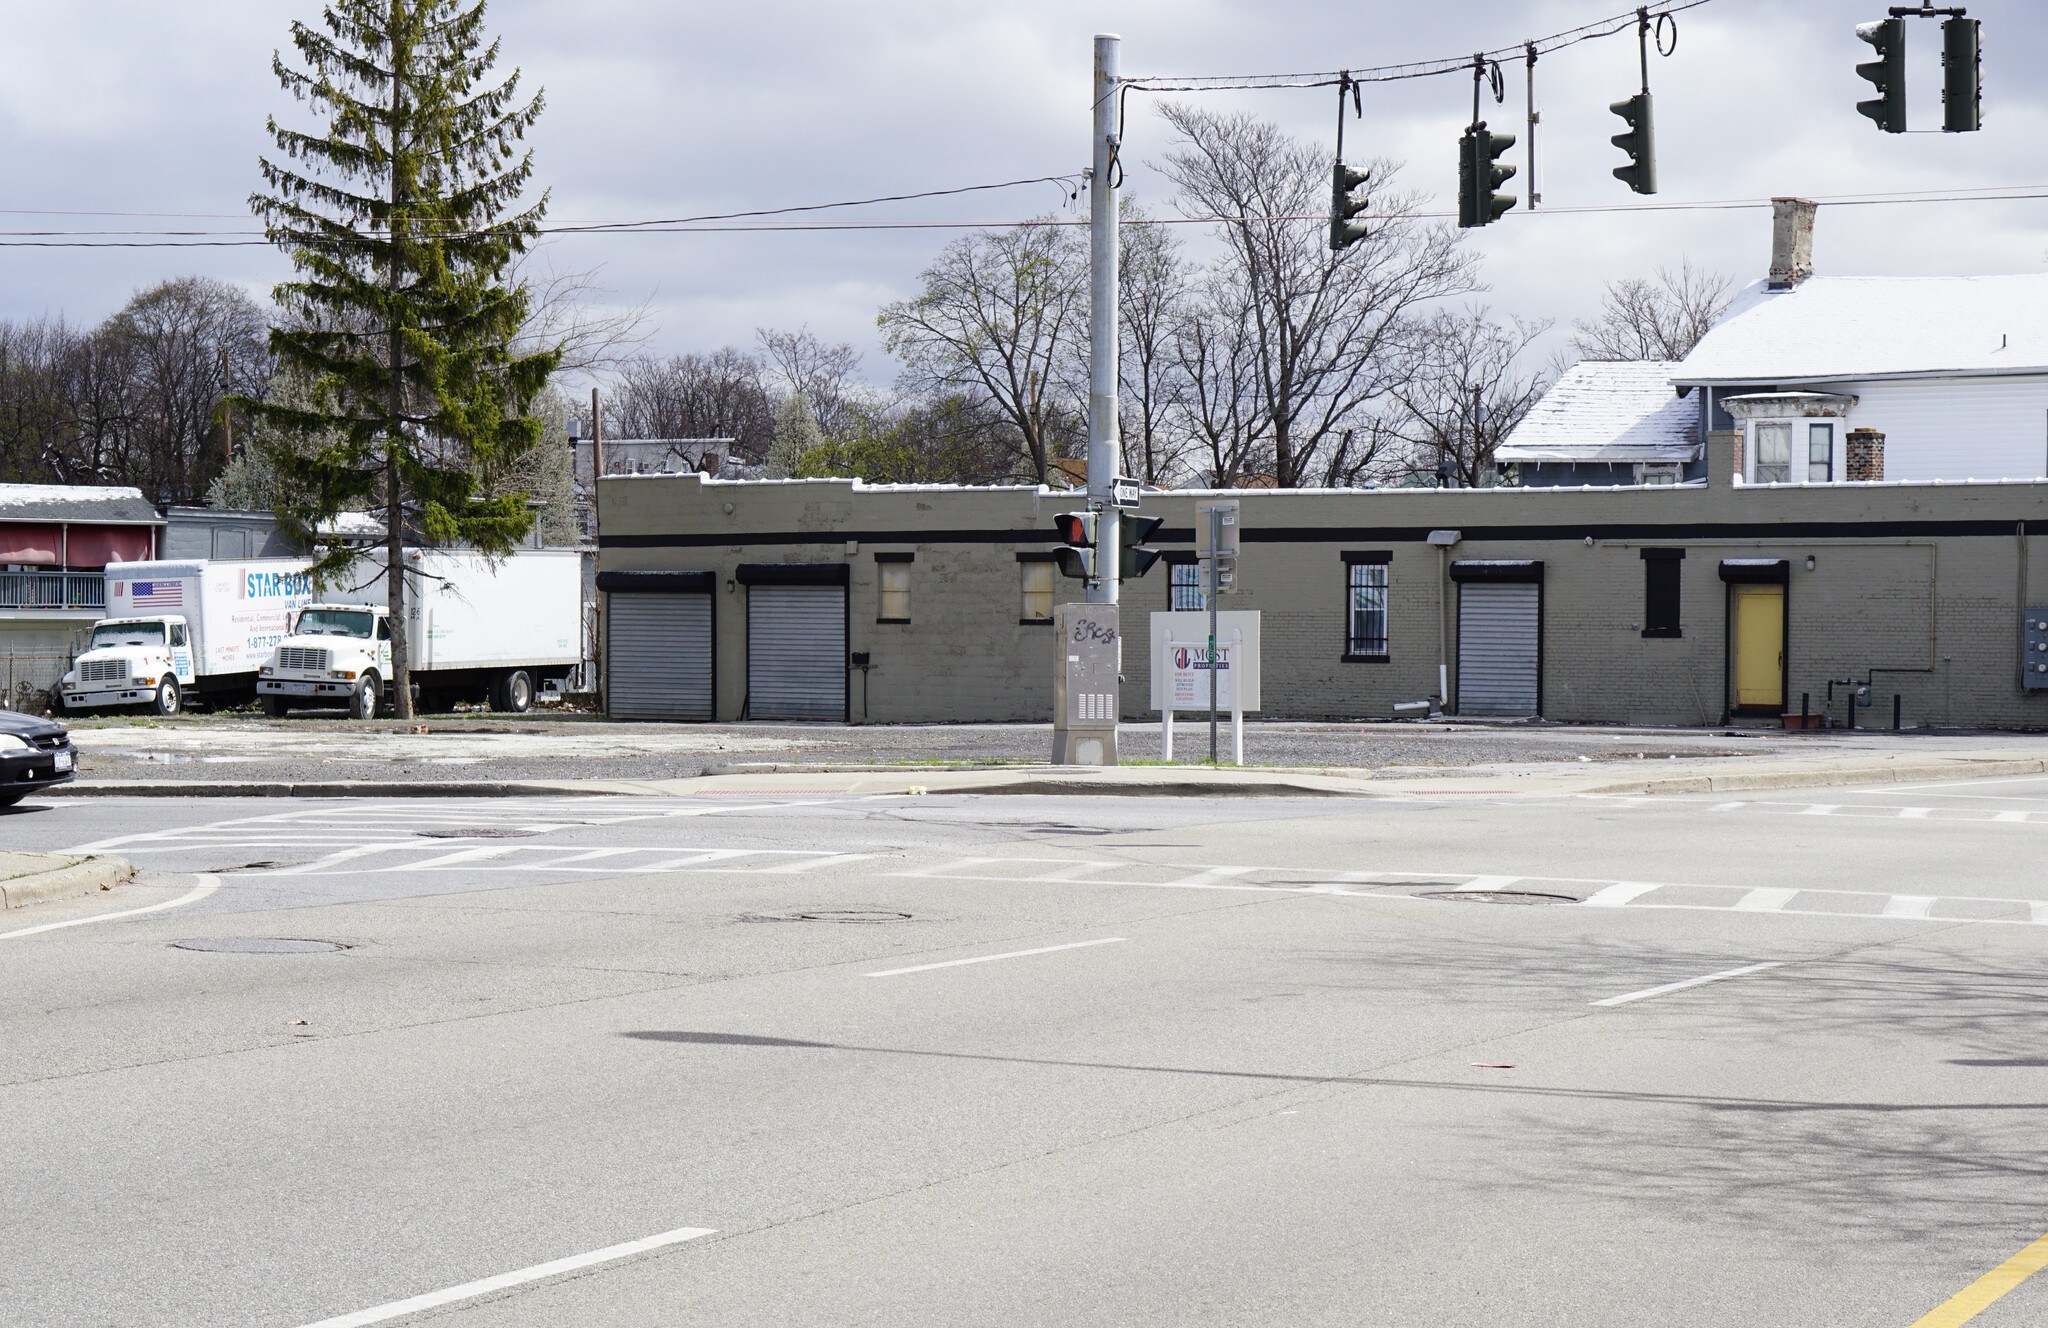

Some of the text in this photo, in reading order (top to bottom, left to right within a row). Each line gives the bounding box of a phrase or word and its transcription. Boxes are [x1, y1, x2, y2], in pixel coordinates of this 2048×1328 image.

[1120, 487, 1137, 499] ONE WAY
[248, 573, 281, 597] STAR
[284, 571, 311, 596] BOX
[285, 600, 296, 609] VAN
[250, 625, 258, 633] And
[226, 645, 239, 653] MINUTE
